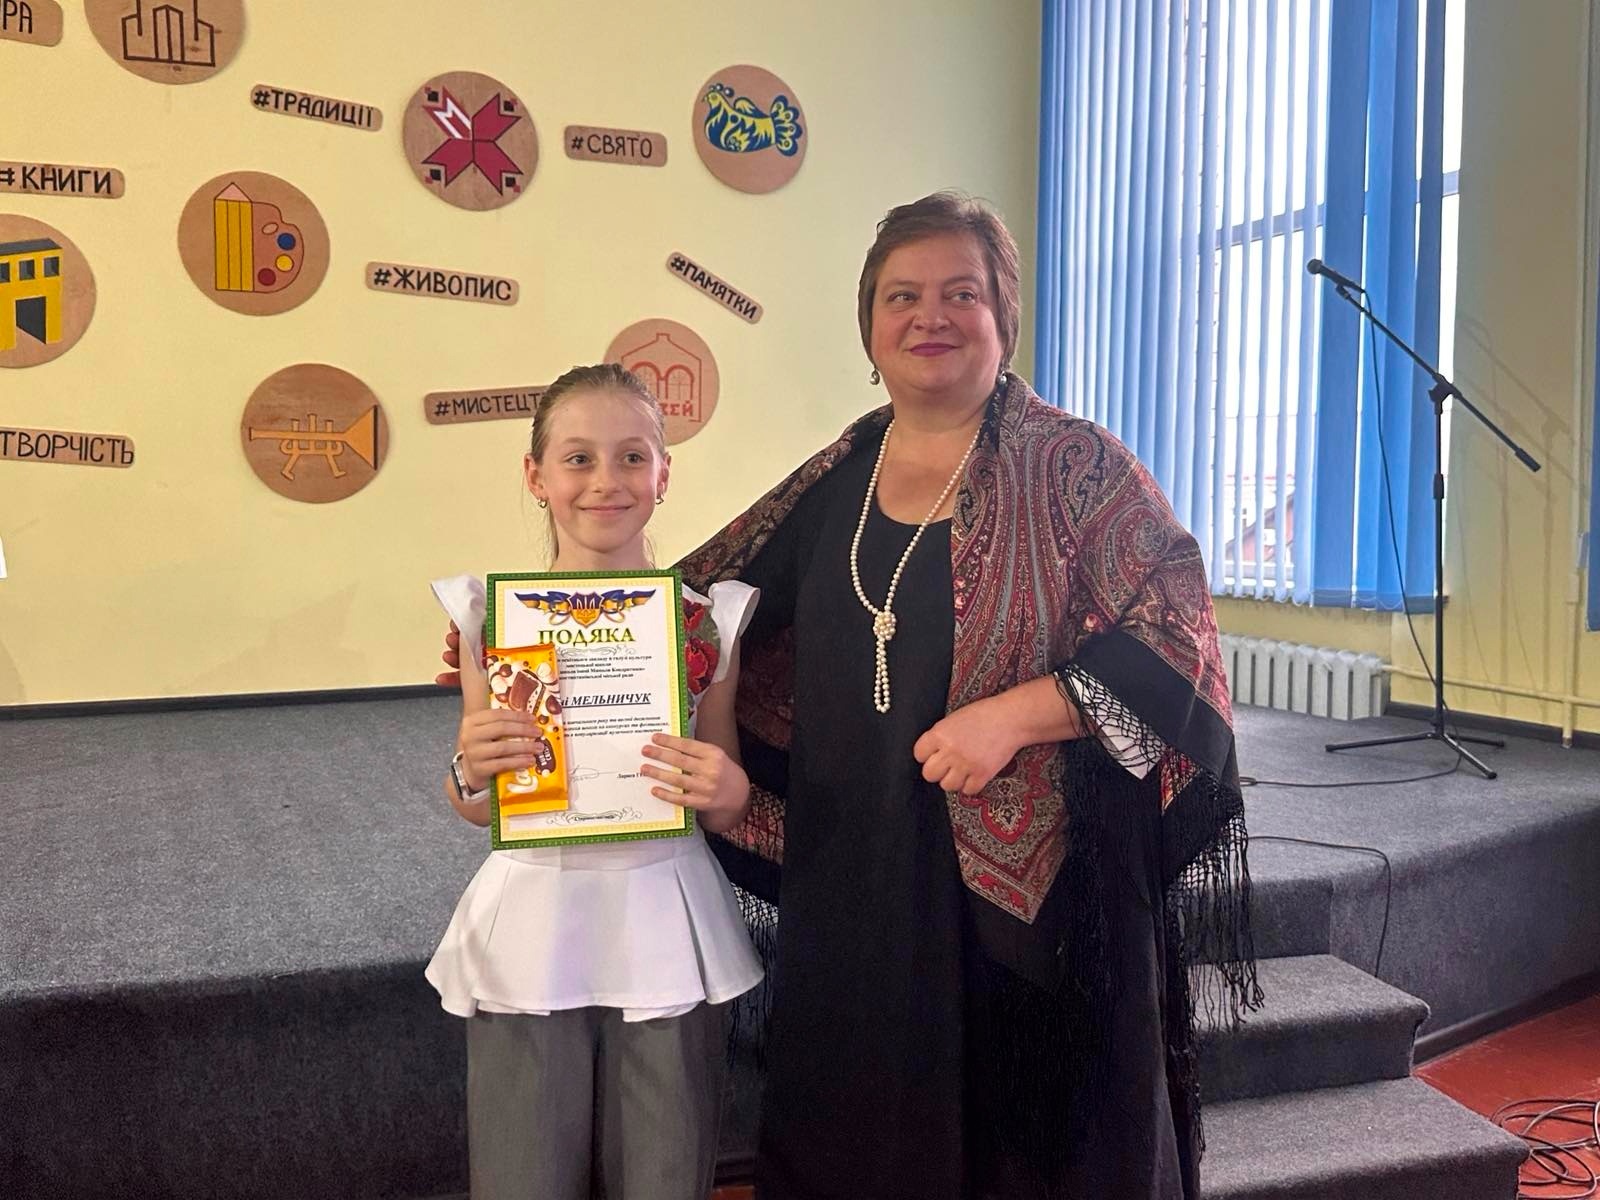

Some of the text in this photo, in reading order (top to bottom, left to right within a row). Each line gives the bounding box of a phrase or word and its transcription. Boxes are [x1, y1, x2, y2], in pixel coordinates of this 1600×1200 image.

[253, 88, 374, 127] #ТРАДИЦІЇ
[571, 134, 652, 158] #СВЯТО
[373, 267, 512, 301] #ЖИВОПИС
[671, 256, 757, 319] #ПАМЯТКИ
[434, 392, 545, 416] #МИСТЕЦТ
[538, 628, 635, 647] ПОДЯКА
[571, 692, 652, 706] МЕЛЬНИЧУК
